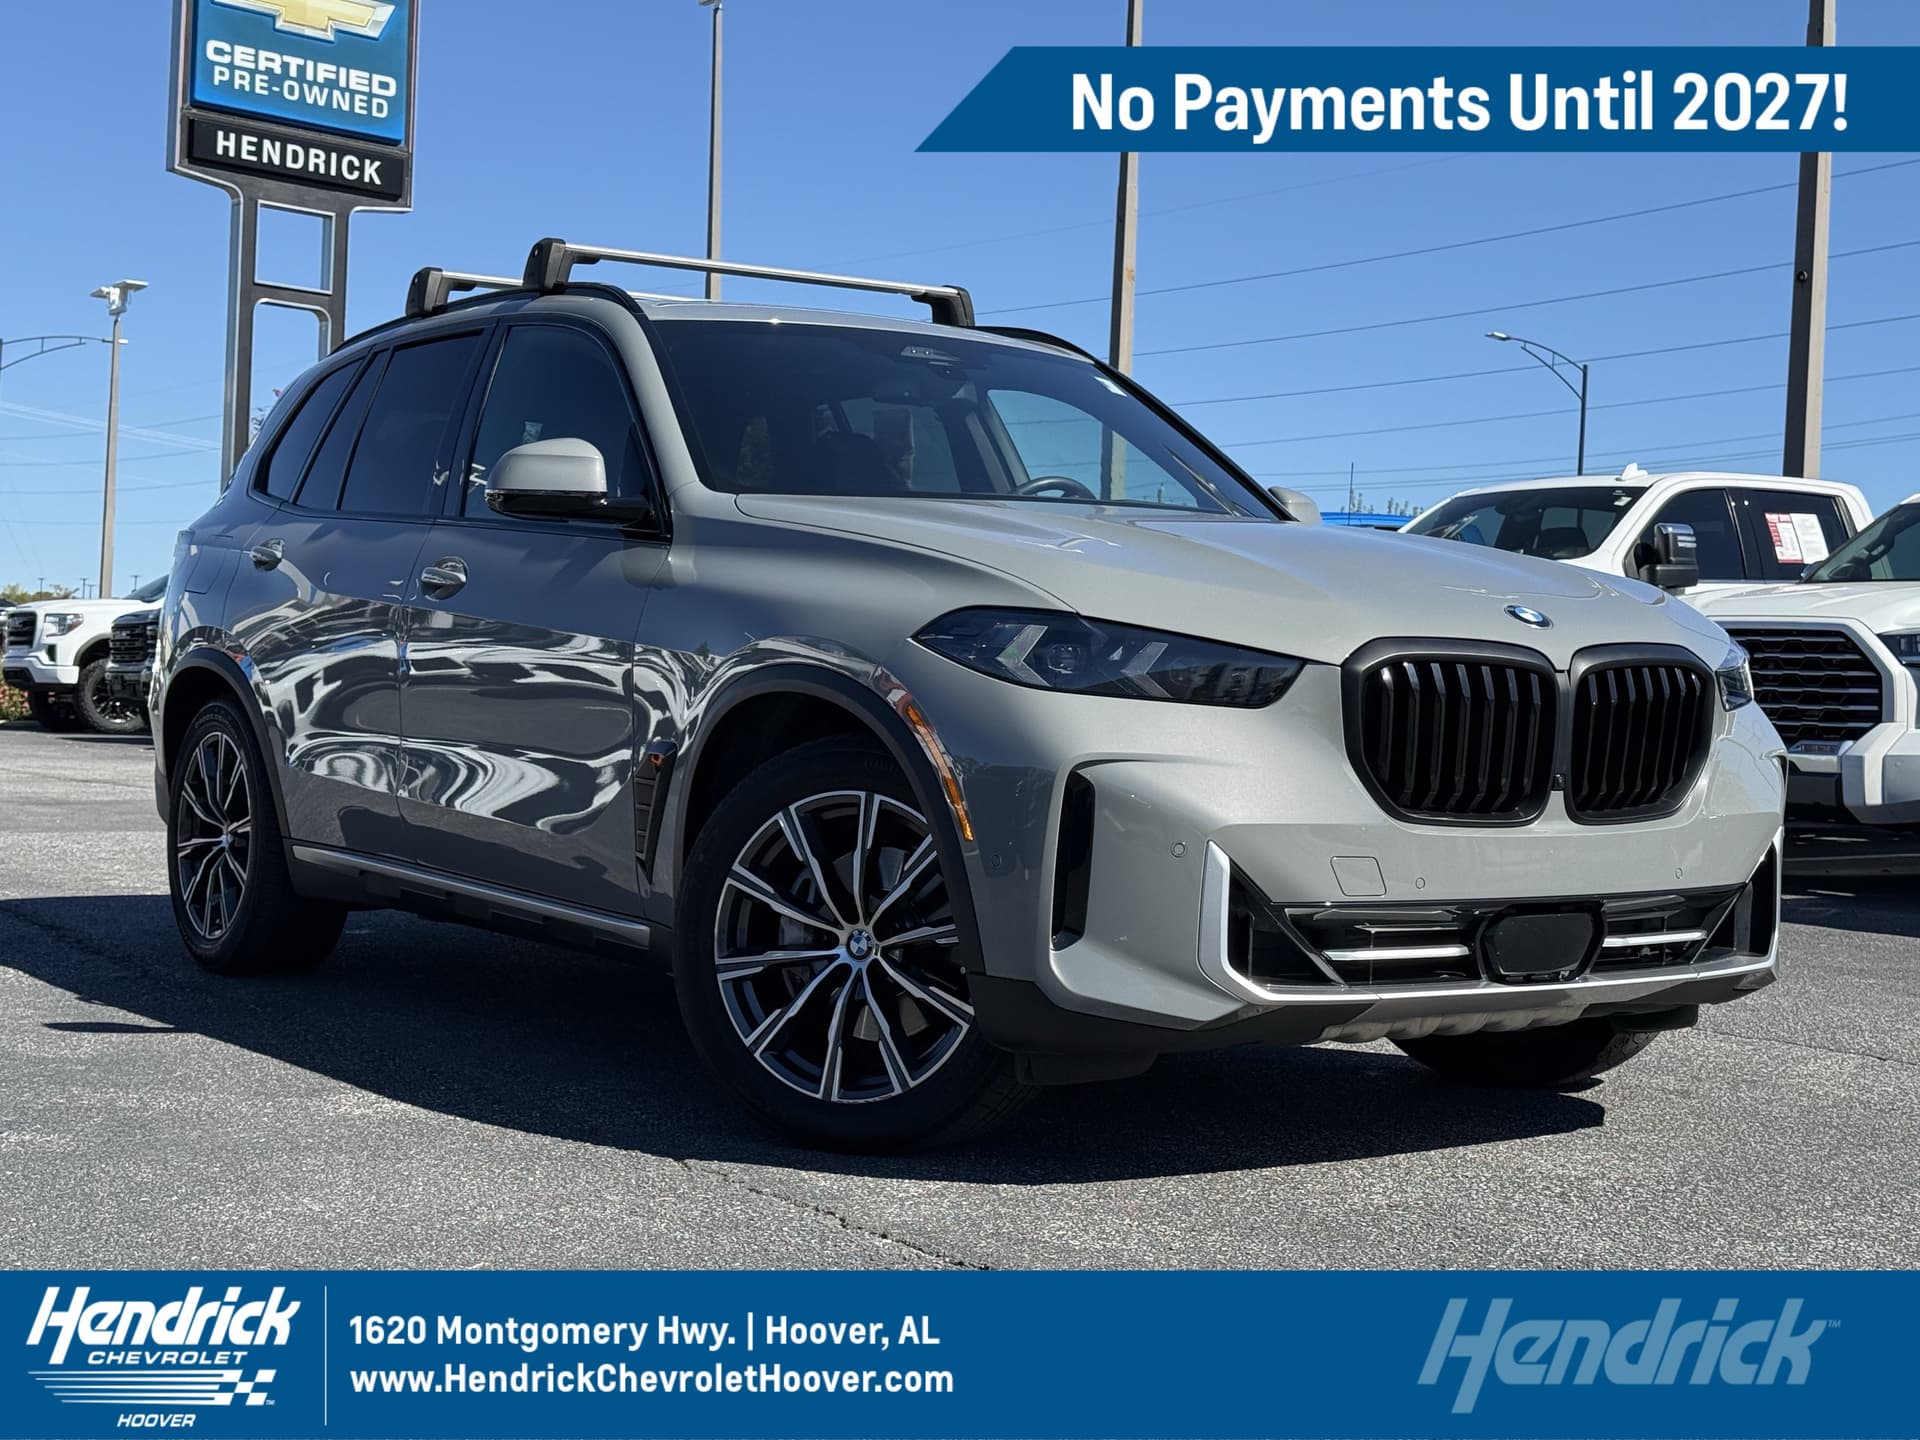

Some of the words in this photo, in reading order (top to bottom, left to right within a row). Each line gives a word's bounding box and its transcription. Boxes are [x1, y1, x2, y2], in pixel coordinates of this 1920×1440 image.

[206, 39, 397, 97] CERTIFIED
[213, 66, 389, 118] PRE-OWNED
[216, 130, 382, 185] HENDRICK
